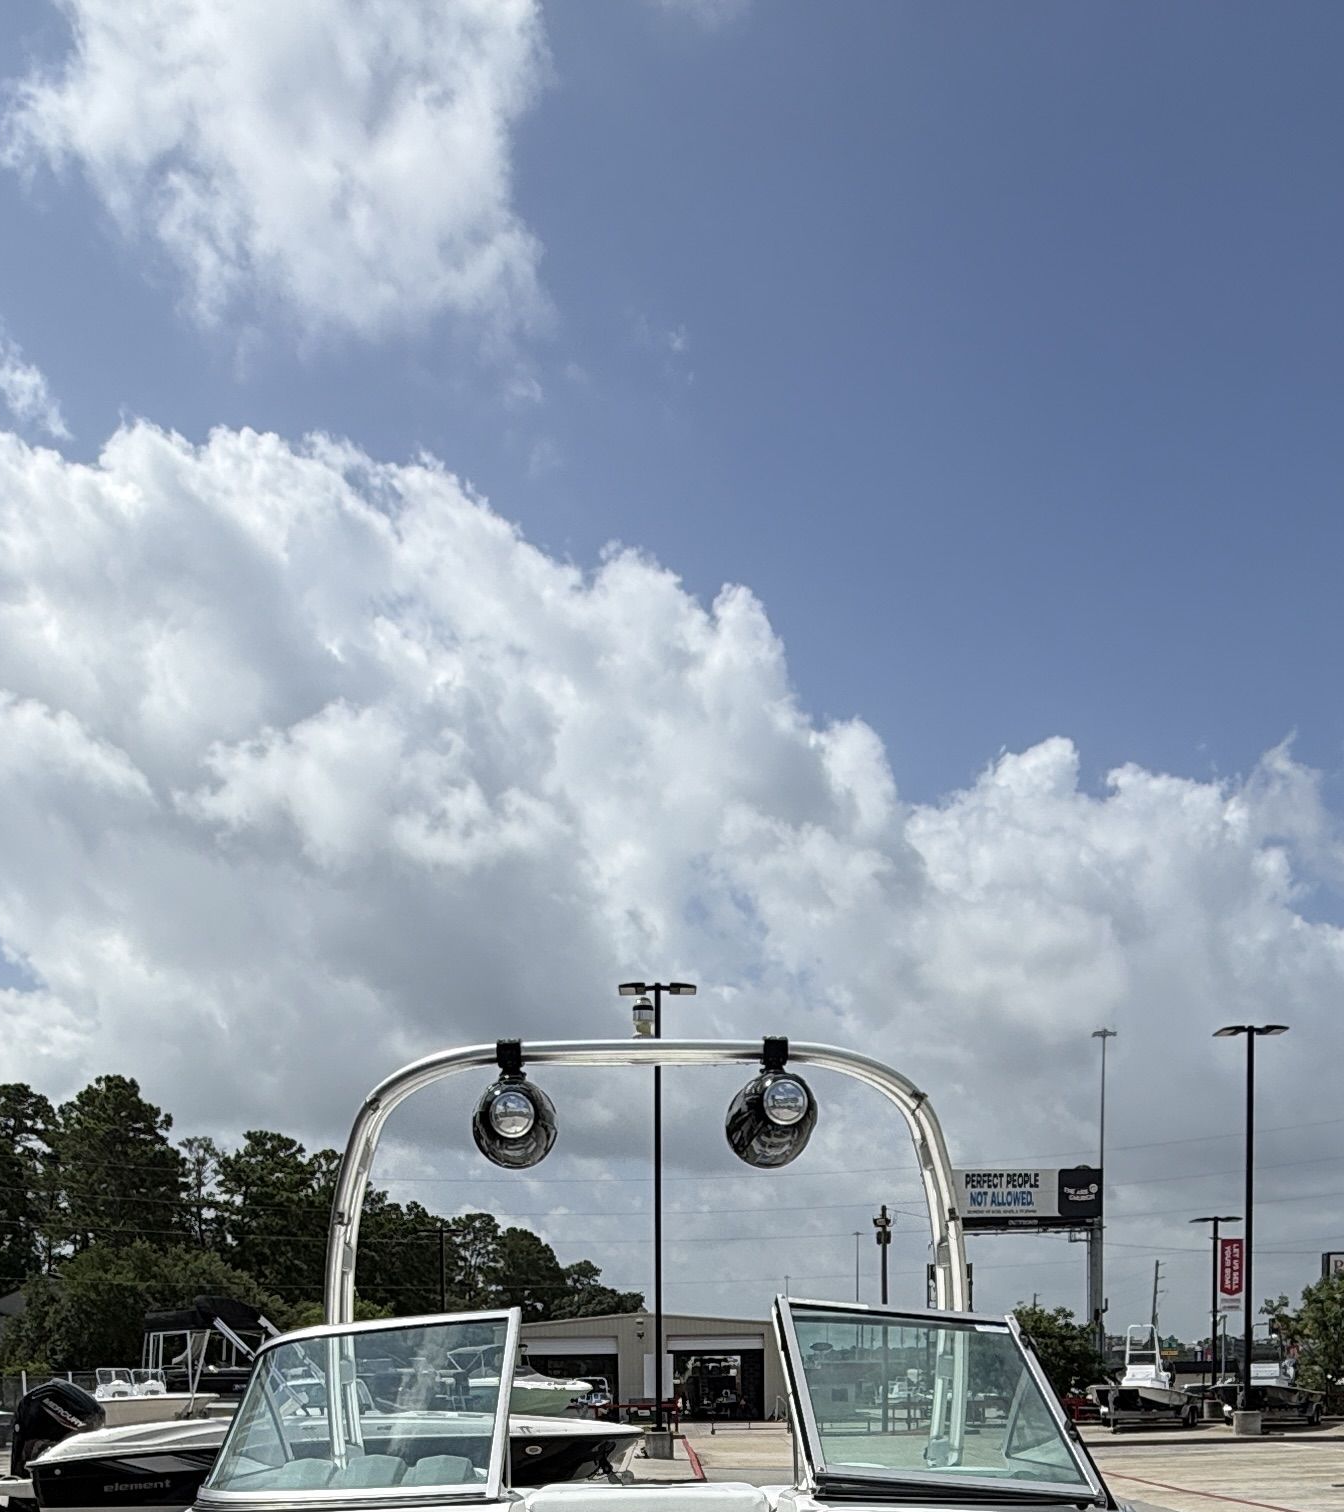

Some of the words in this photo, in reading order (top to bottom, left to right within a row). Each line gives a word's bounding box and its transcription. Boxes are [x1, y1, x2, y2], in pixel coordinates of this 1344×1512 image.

[965, 1173, 1004, 1189] PERFECT
[1006, 1173, 1039, 1189] PEOPLE
[970, 1191, 989, 1207] NOT
[1224, 1246, 1232, 1266] YOUR
[1232, 1243, 1240, 1258] LET
[1224, 1268, 1232, 1290] BOAT
[1232, 1271, 1240, 1291] SELL
[42, 1398, 86, 1427] MERCURY
[103, 1479, 172, 1493] element
